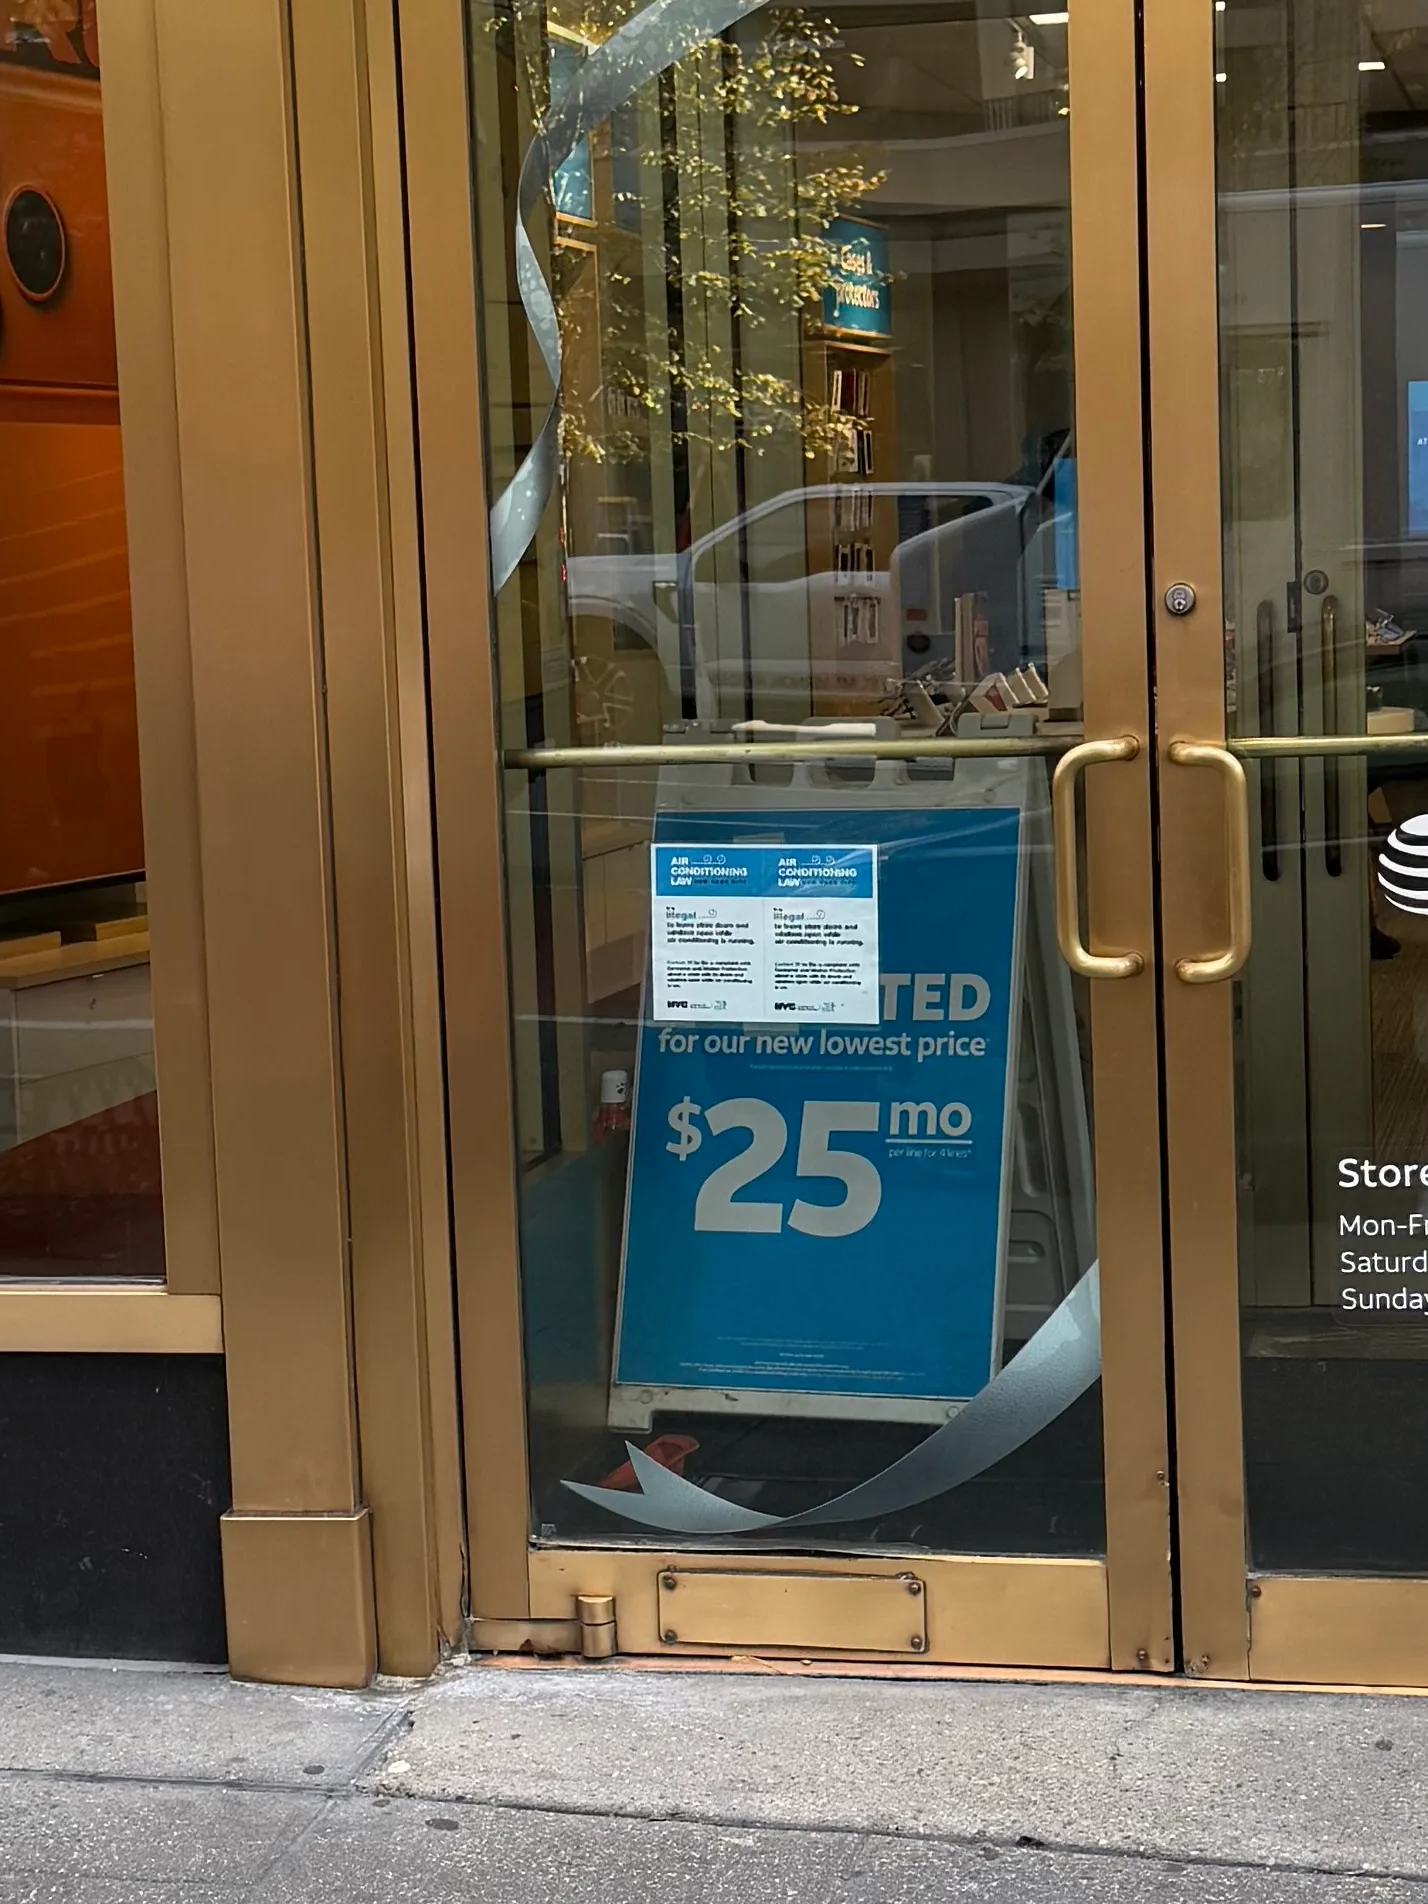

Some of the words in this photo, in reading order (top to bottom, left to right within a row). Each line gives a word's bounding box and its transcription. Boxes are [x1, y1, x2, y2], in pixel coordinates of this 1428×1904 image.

[670, 857, 689, 866] AIR
[778, 858, 797, 867] AIR
[670, 867, 748, 877] CONDITIONING
[778, 868, 857, 878] CONDITIONING
[658, 1027, 699, 1054] for
[704, 1034, 749, 1054] our
[755, 1035, 814, 1055] new
[820, 1029, 911, 1056] lowest
[665, 1096, 882, 1238] $25
[889, 1101, 972, 1137] mo
